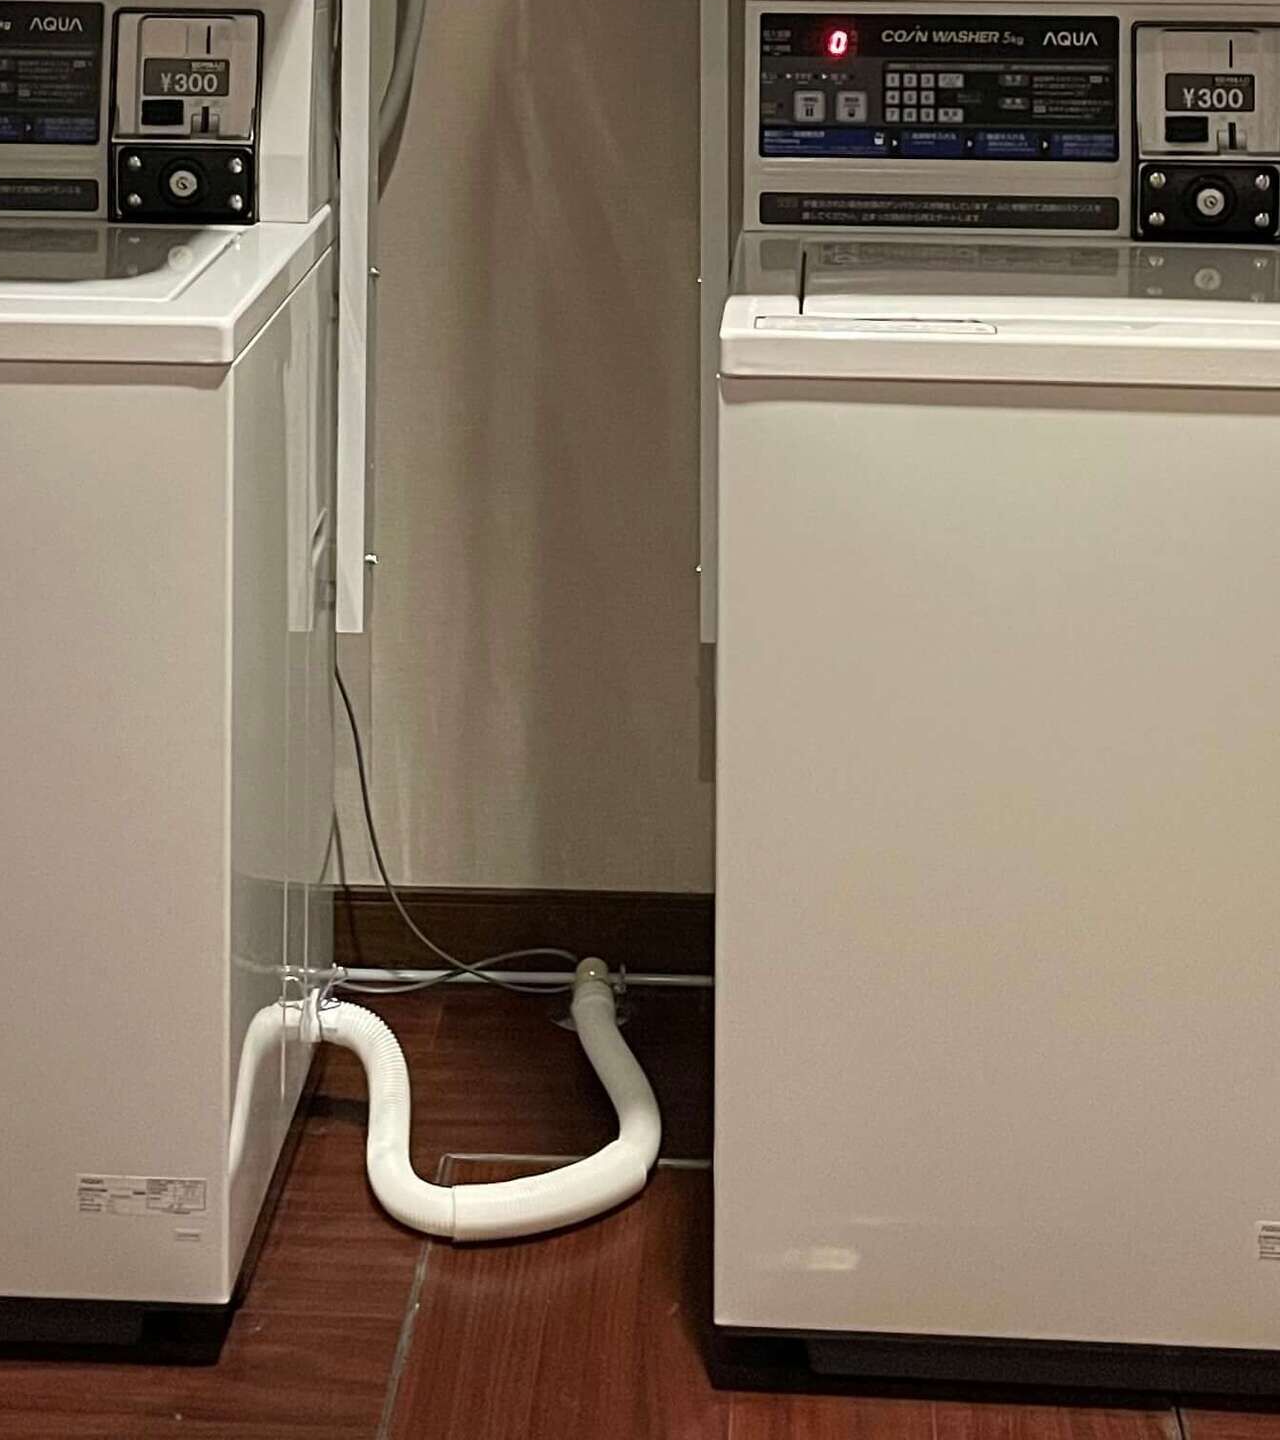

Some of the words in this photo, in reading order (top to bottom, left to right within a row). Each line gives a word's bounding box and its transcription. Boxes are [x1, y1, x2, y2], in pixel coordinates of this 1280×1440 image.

[30, 17, 83, 32] AQUA
[827, 30, 848, 55] 0
[932, 30, 1000, 43] WASHER
[1043, 32, 1099, 47] AQUA
[160, 72, 218, 93] ¥300
[1183, 88, 1244, 109] ¥300
